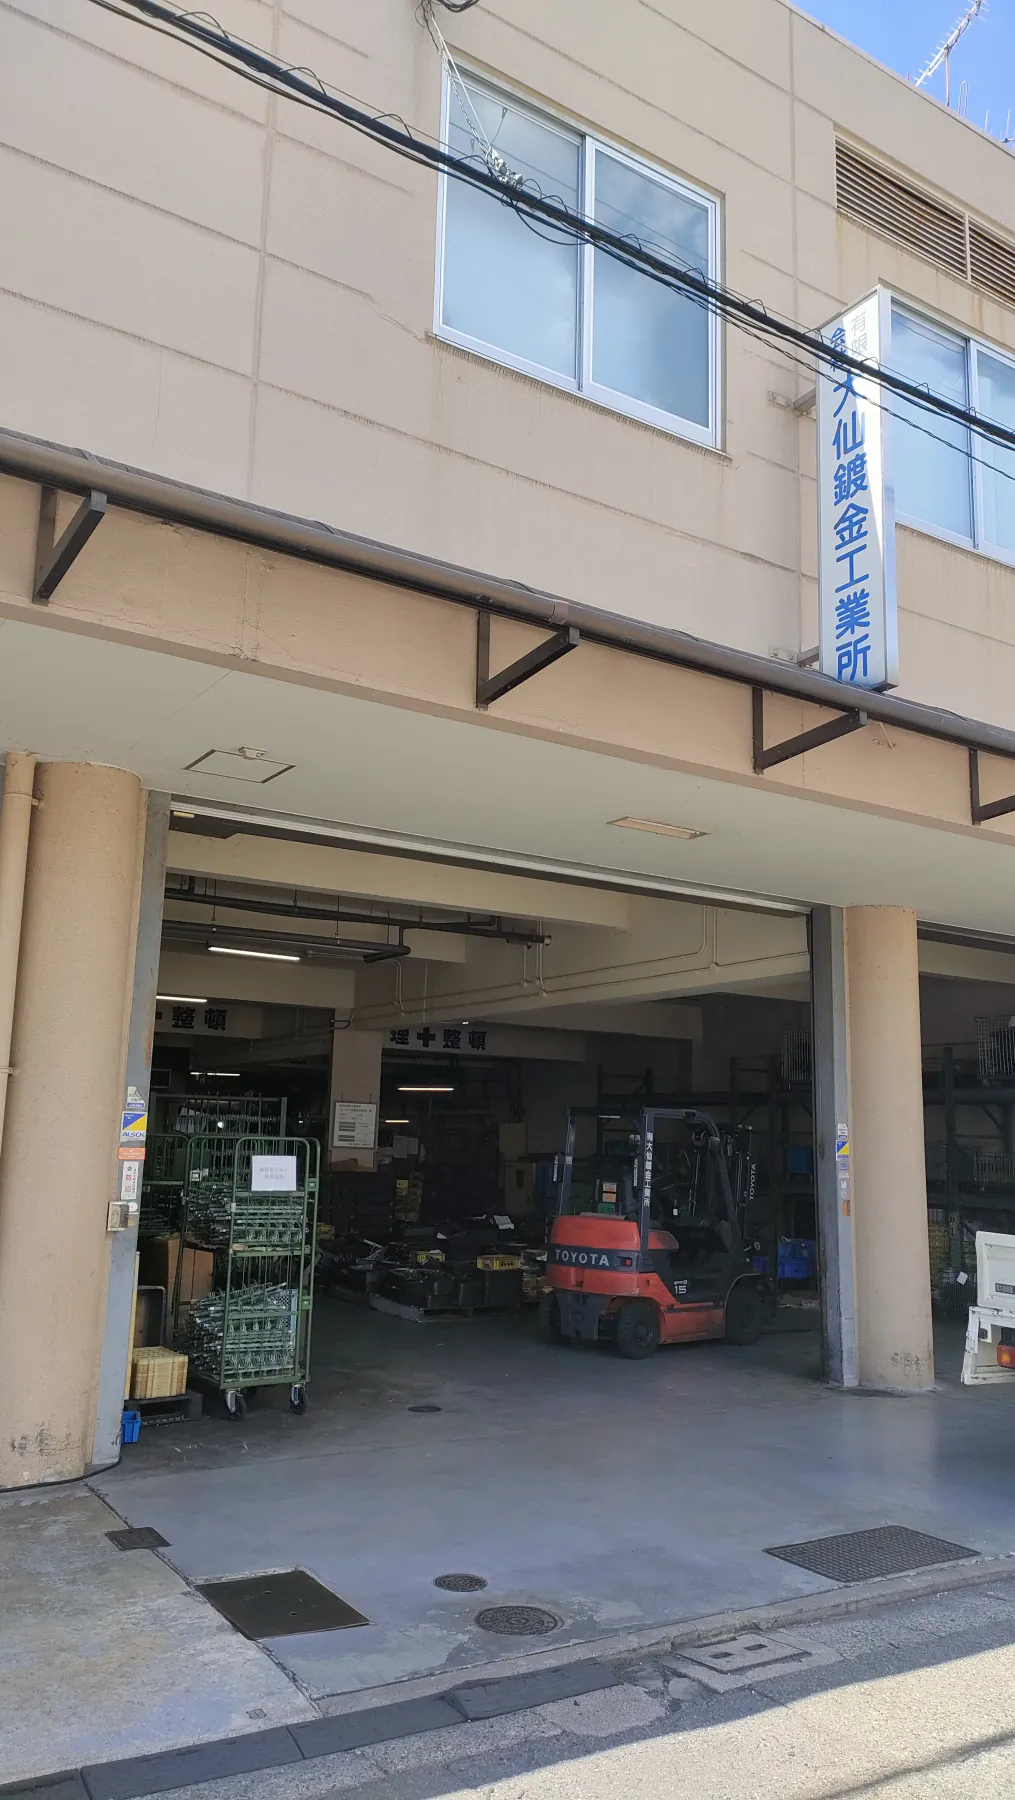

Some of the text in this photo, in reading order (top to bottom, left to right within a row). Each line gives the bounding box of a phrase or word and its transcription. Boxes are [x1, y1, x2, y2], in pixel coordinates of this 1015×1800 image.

[850, 309, 868, 358] 有限
[832, 369, 871, 681] 大仙鍍金工業所
[171, 1006, 227, 1031] 整頓
[555, 1249, 609, 1267] TOYOTA
[675, 1285, 687, 1295] 15
